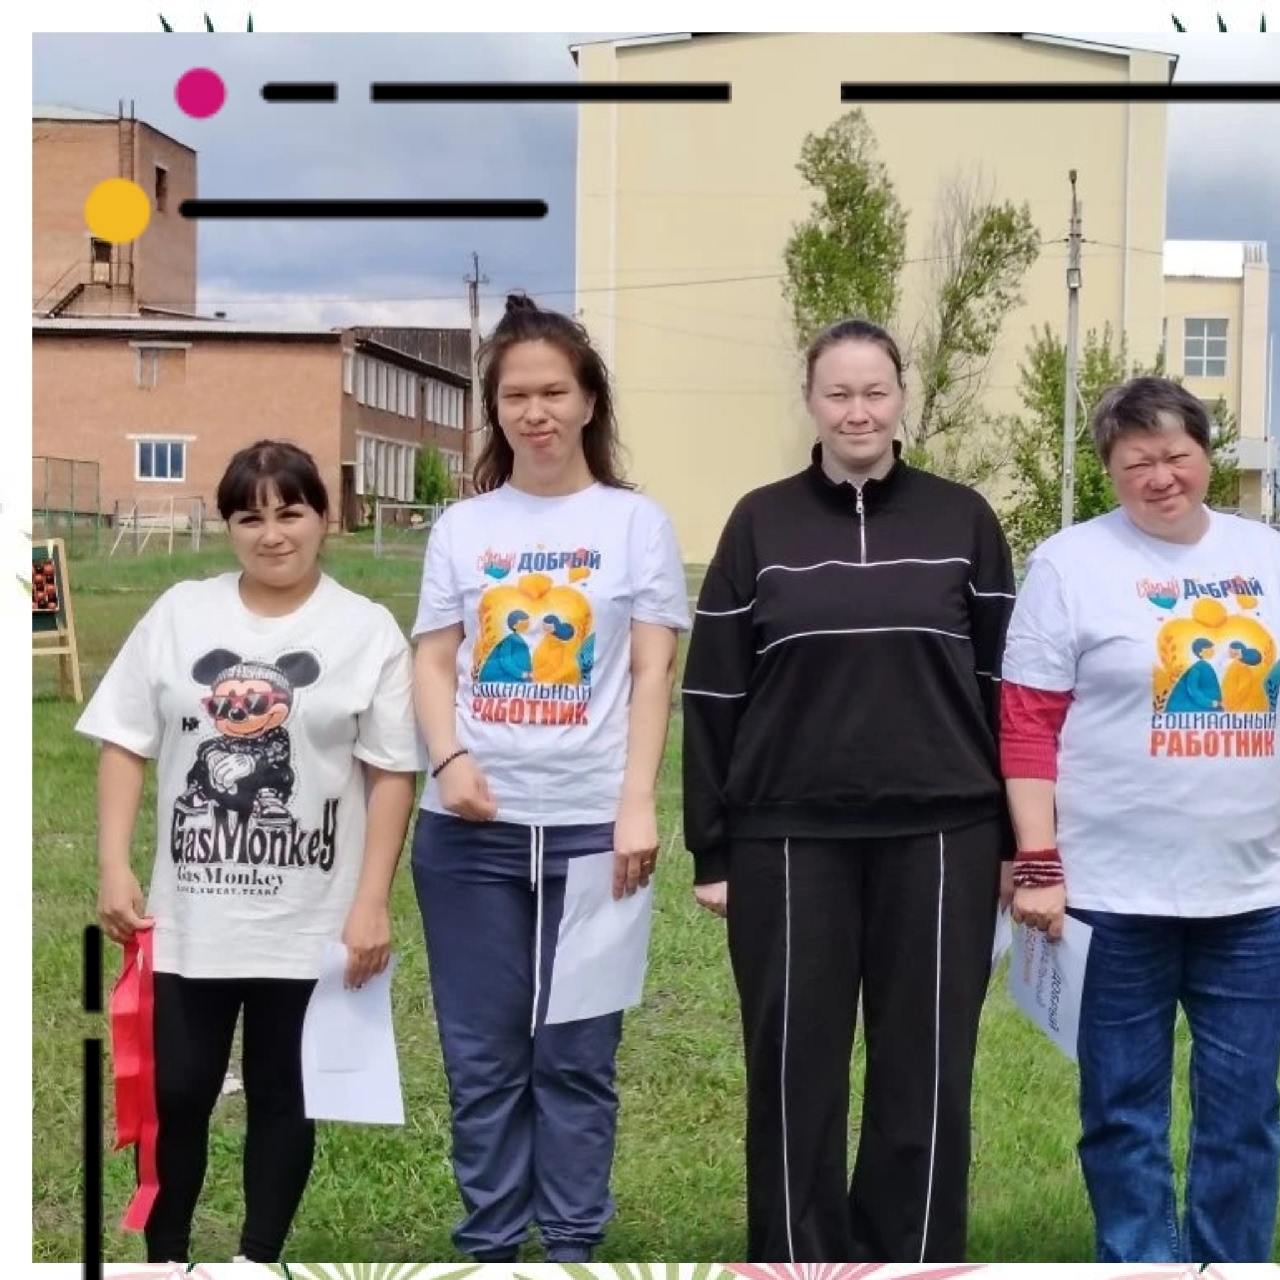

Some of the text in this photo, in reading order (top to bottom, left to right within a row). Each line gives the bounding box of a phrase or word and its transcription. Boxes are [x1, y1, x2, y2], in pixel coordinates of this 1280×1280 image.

[518, 551, 601, 573] ДОБРЫЙ
[472, 698, 589, 726] РАБОТНИК
[1150, 730, 1275, 757] РАБОТНИК
